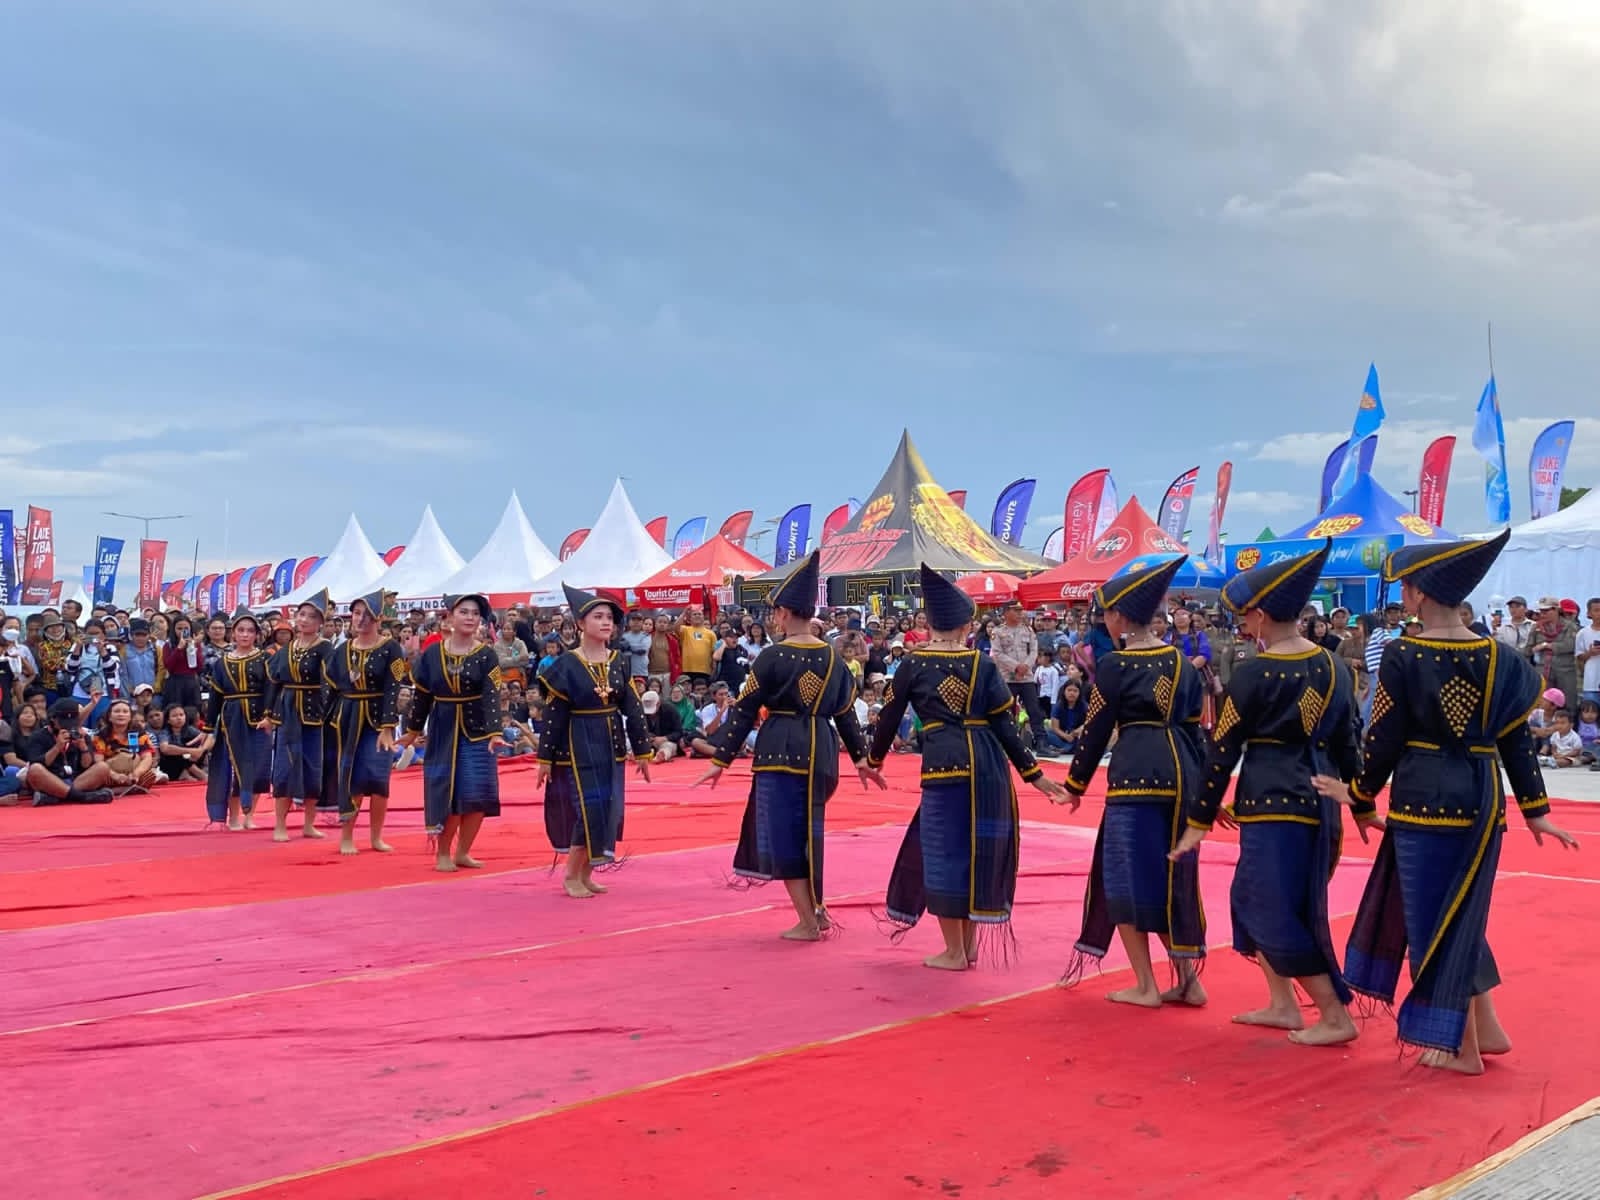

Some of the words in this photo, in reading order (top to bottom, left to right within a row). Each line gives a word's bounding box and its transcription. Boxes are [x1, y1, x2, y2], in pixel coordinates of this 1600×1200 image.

[644, 589, 667, 598] Tourist
[667, 588, 691, 597] Corner
[394, 602, 414, 610] ANK
